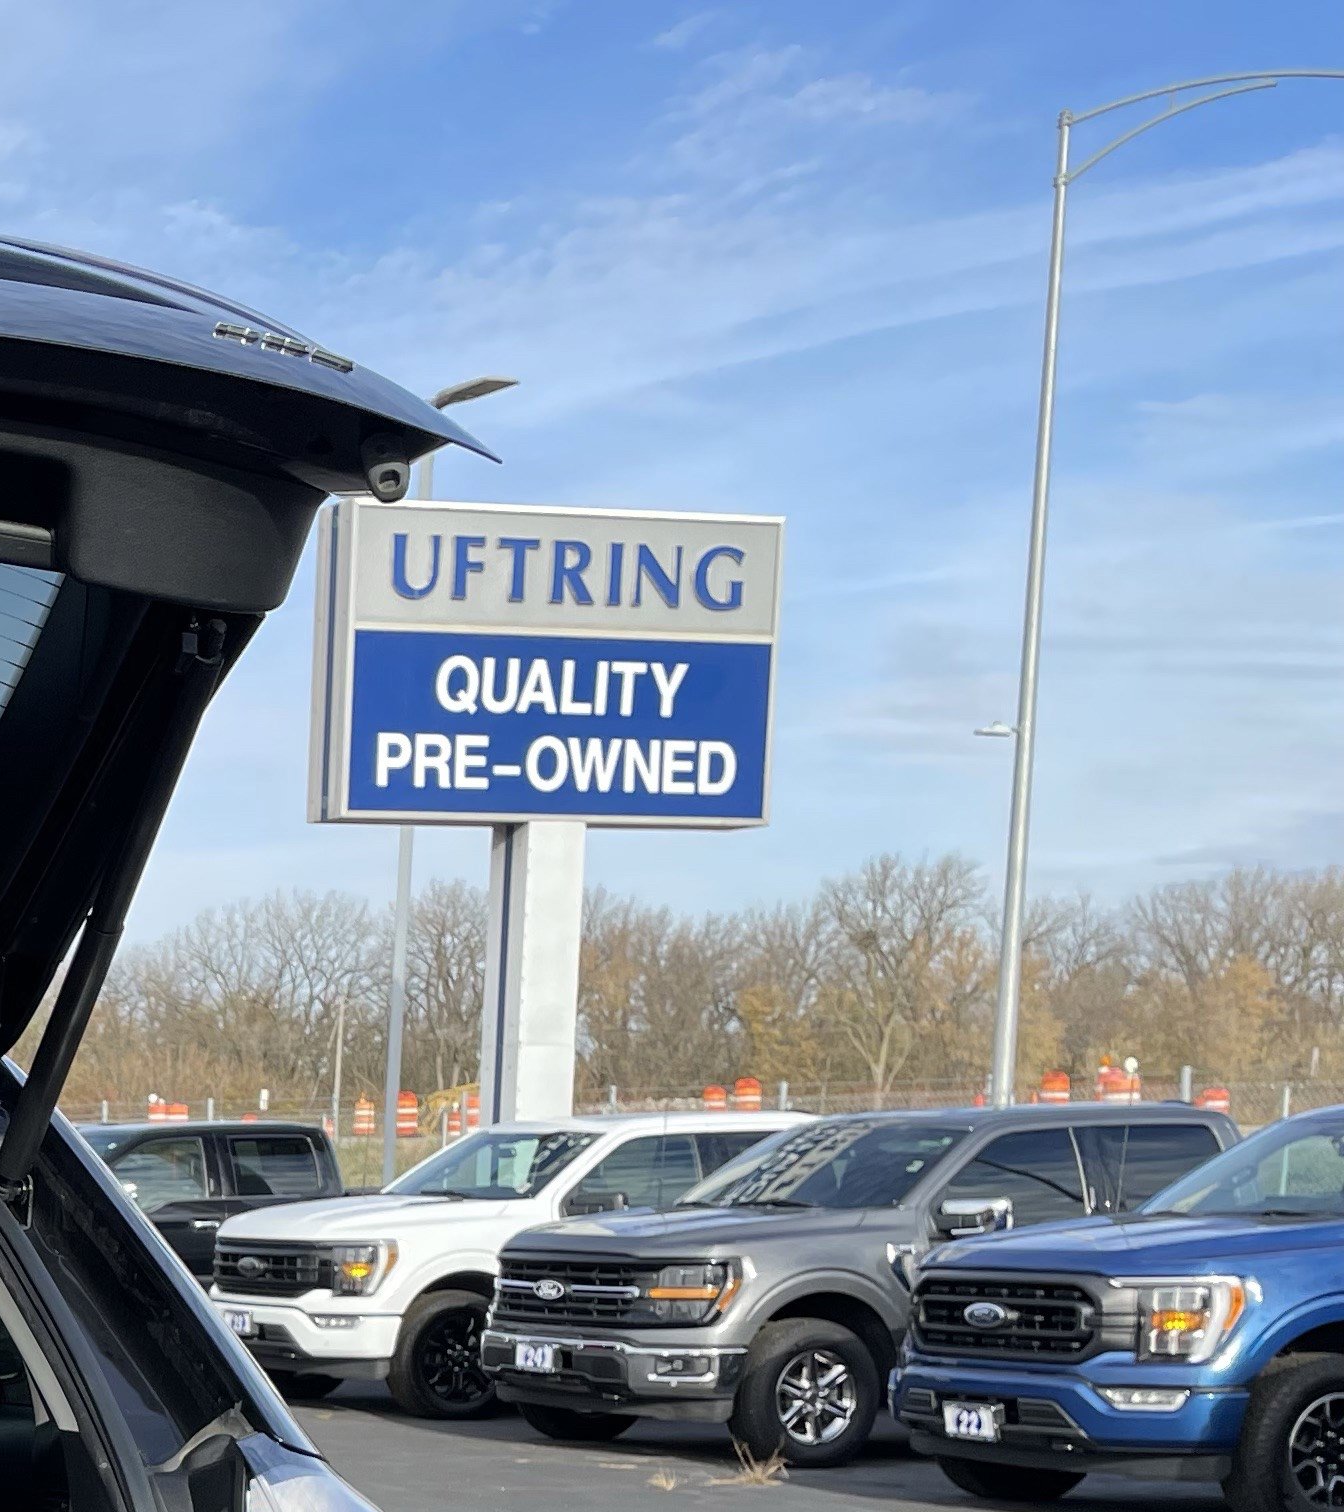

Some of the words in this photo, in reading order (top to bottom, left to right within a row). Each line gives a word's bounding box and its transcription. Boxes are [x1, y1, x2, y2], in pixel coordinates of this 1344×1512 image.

[391, 533, 744, 611] UFTRING
[435, 655, 689, 719] QUALITY
[375, 732, 738, 796] PRE-OWNED
